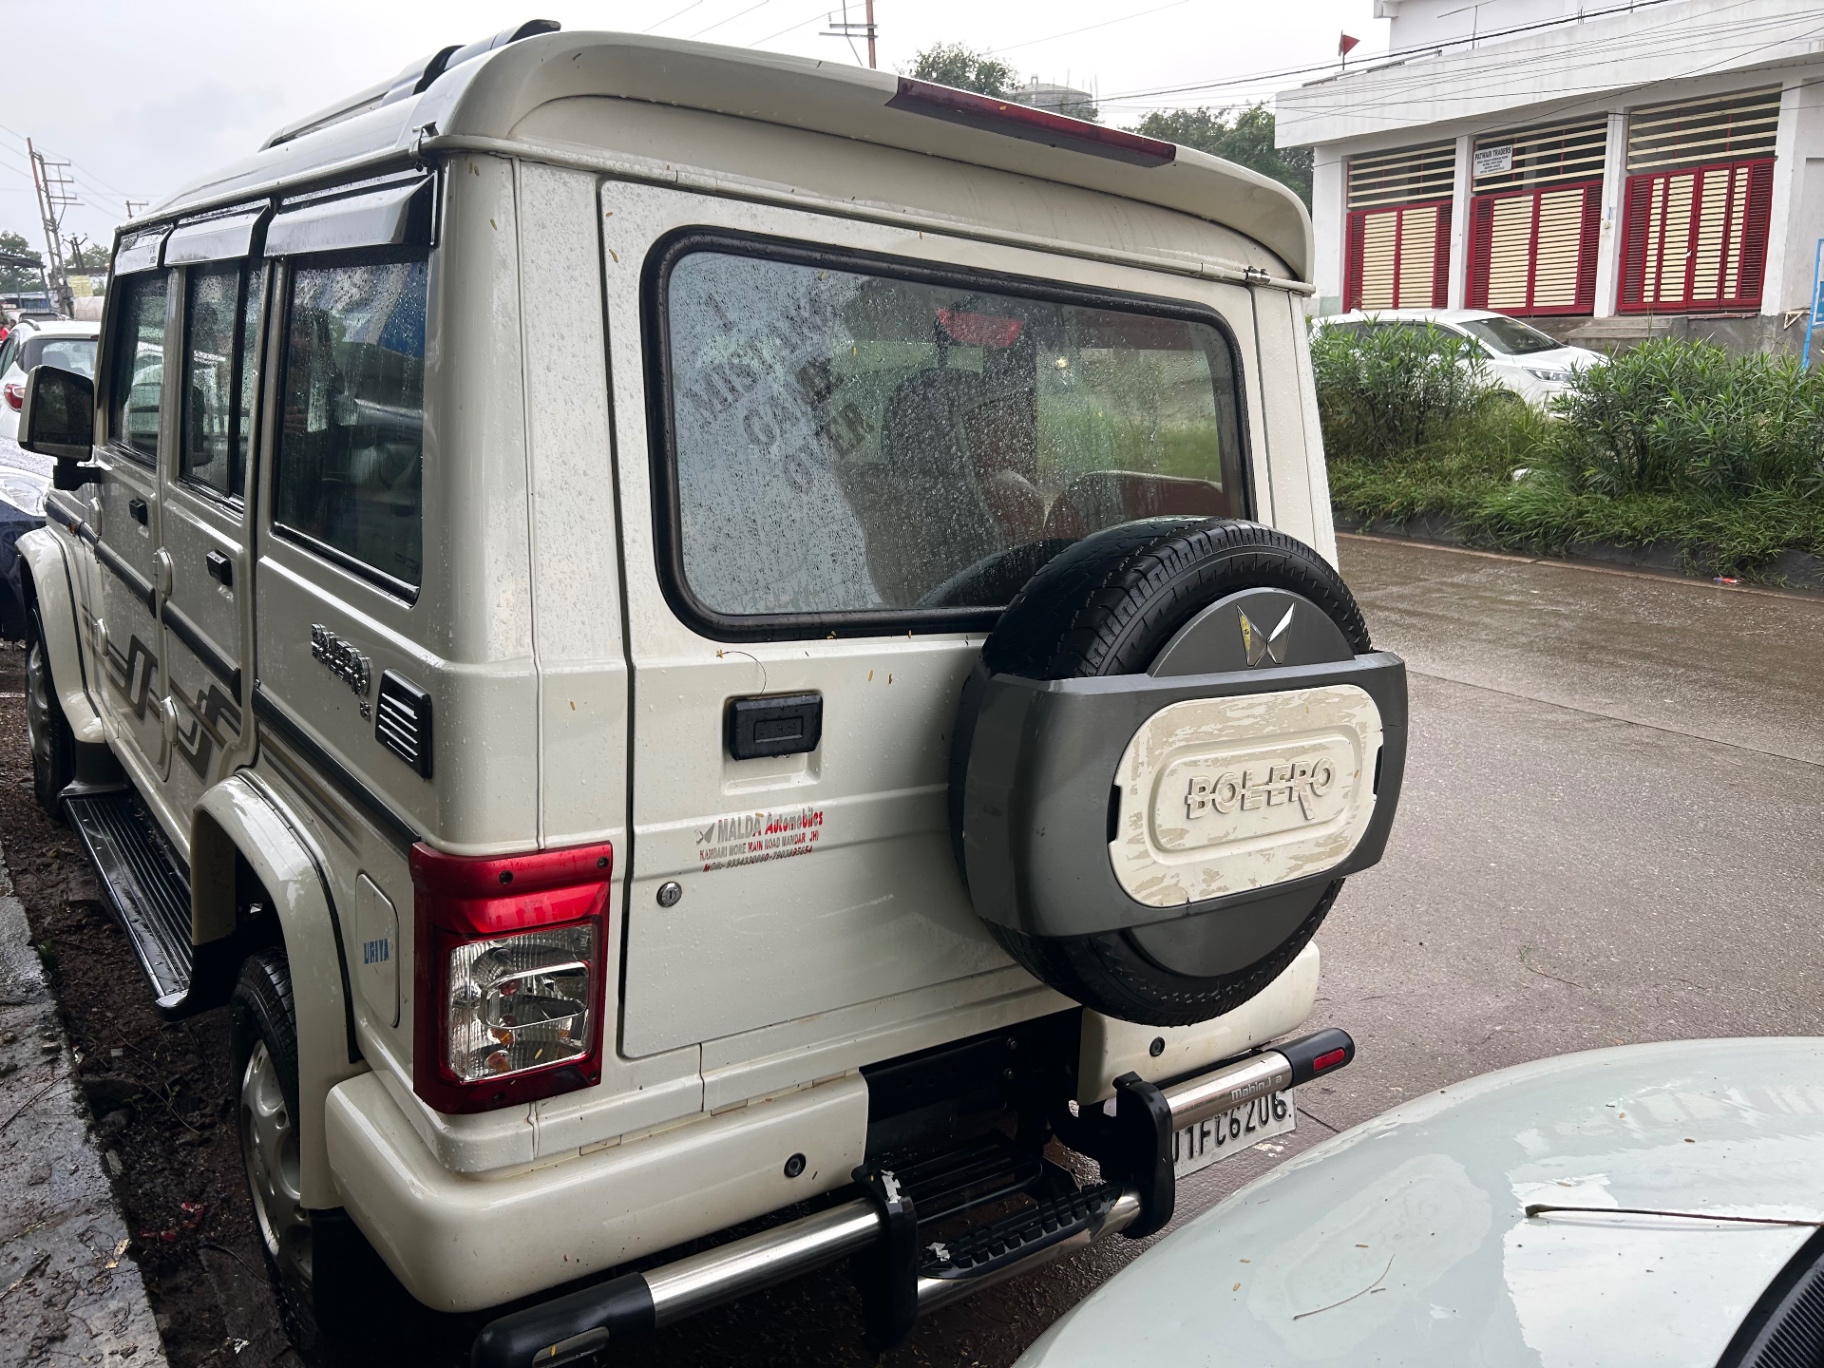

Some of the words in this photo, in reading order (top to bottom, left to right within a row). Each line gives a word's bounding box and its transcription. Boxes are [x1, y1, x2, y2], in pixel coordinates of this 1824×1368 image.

[1493, 146, 1512, 157] TRADERS
[1185, 757, 1336, 820] BOLERO
[717, 814, 762, 844] MALDA
[764, 806, 824, 835] Automobiles
[747, 839, 763, 853] MAIN
[764, 837, 781, 850] ROAD
